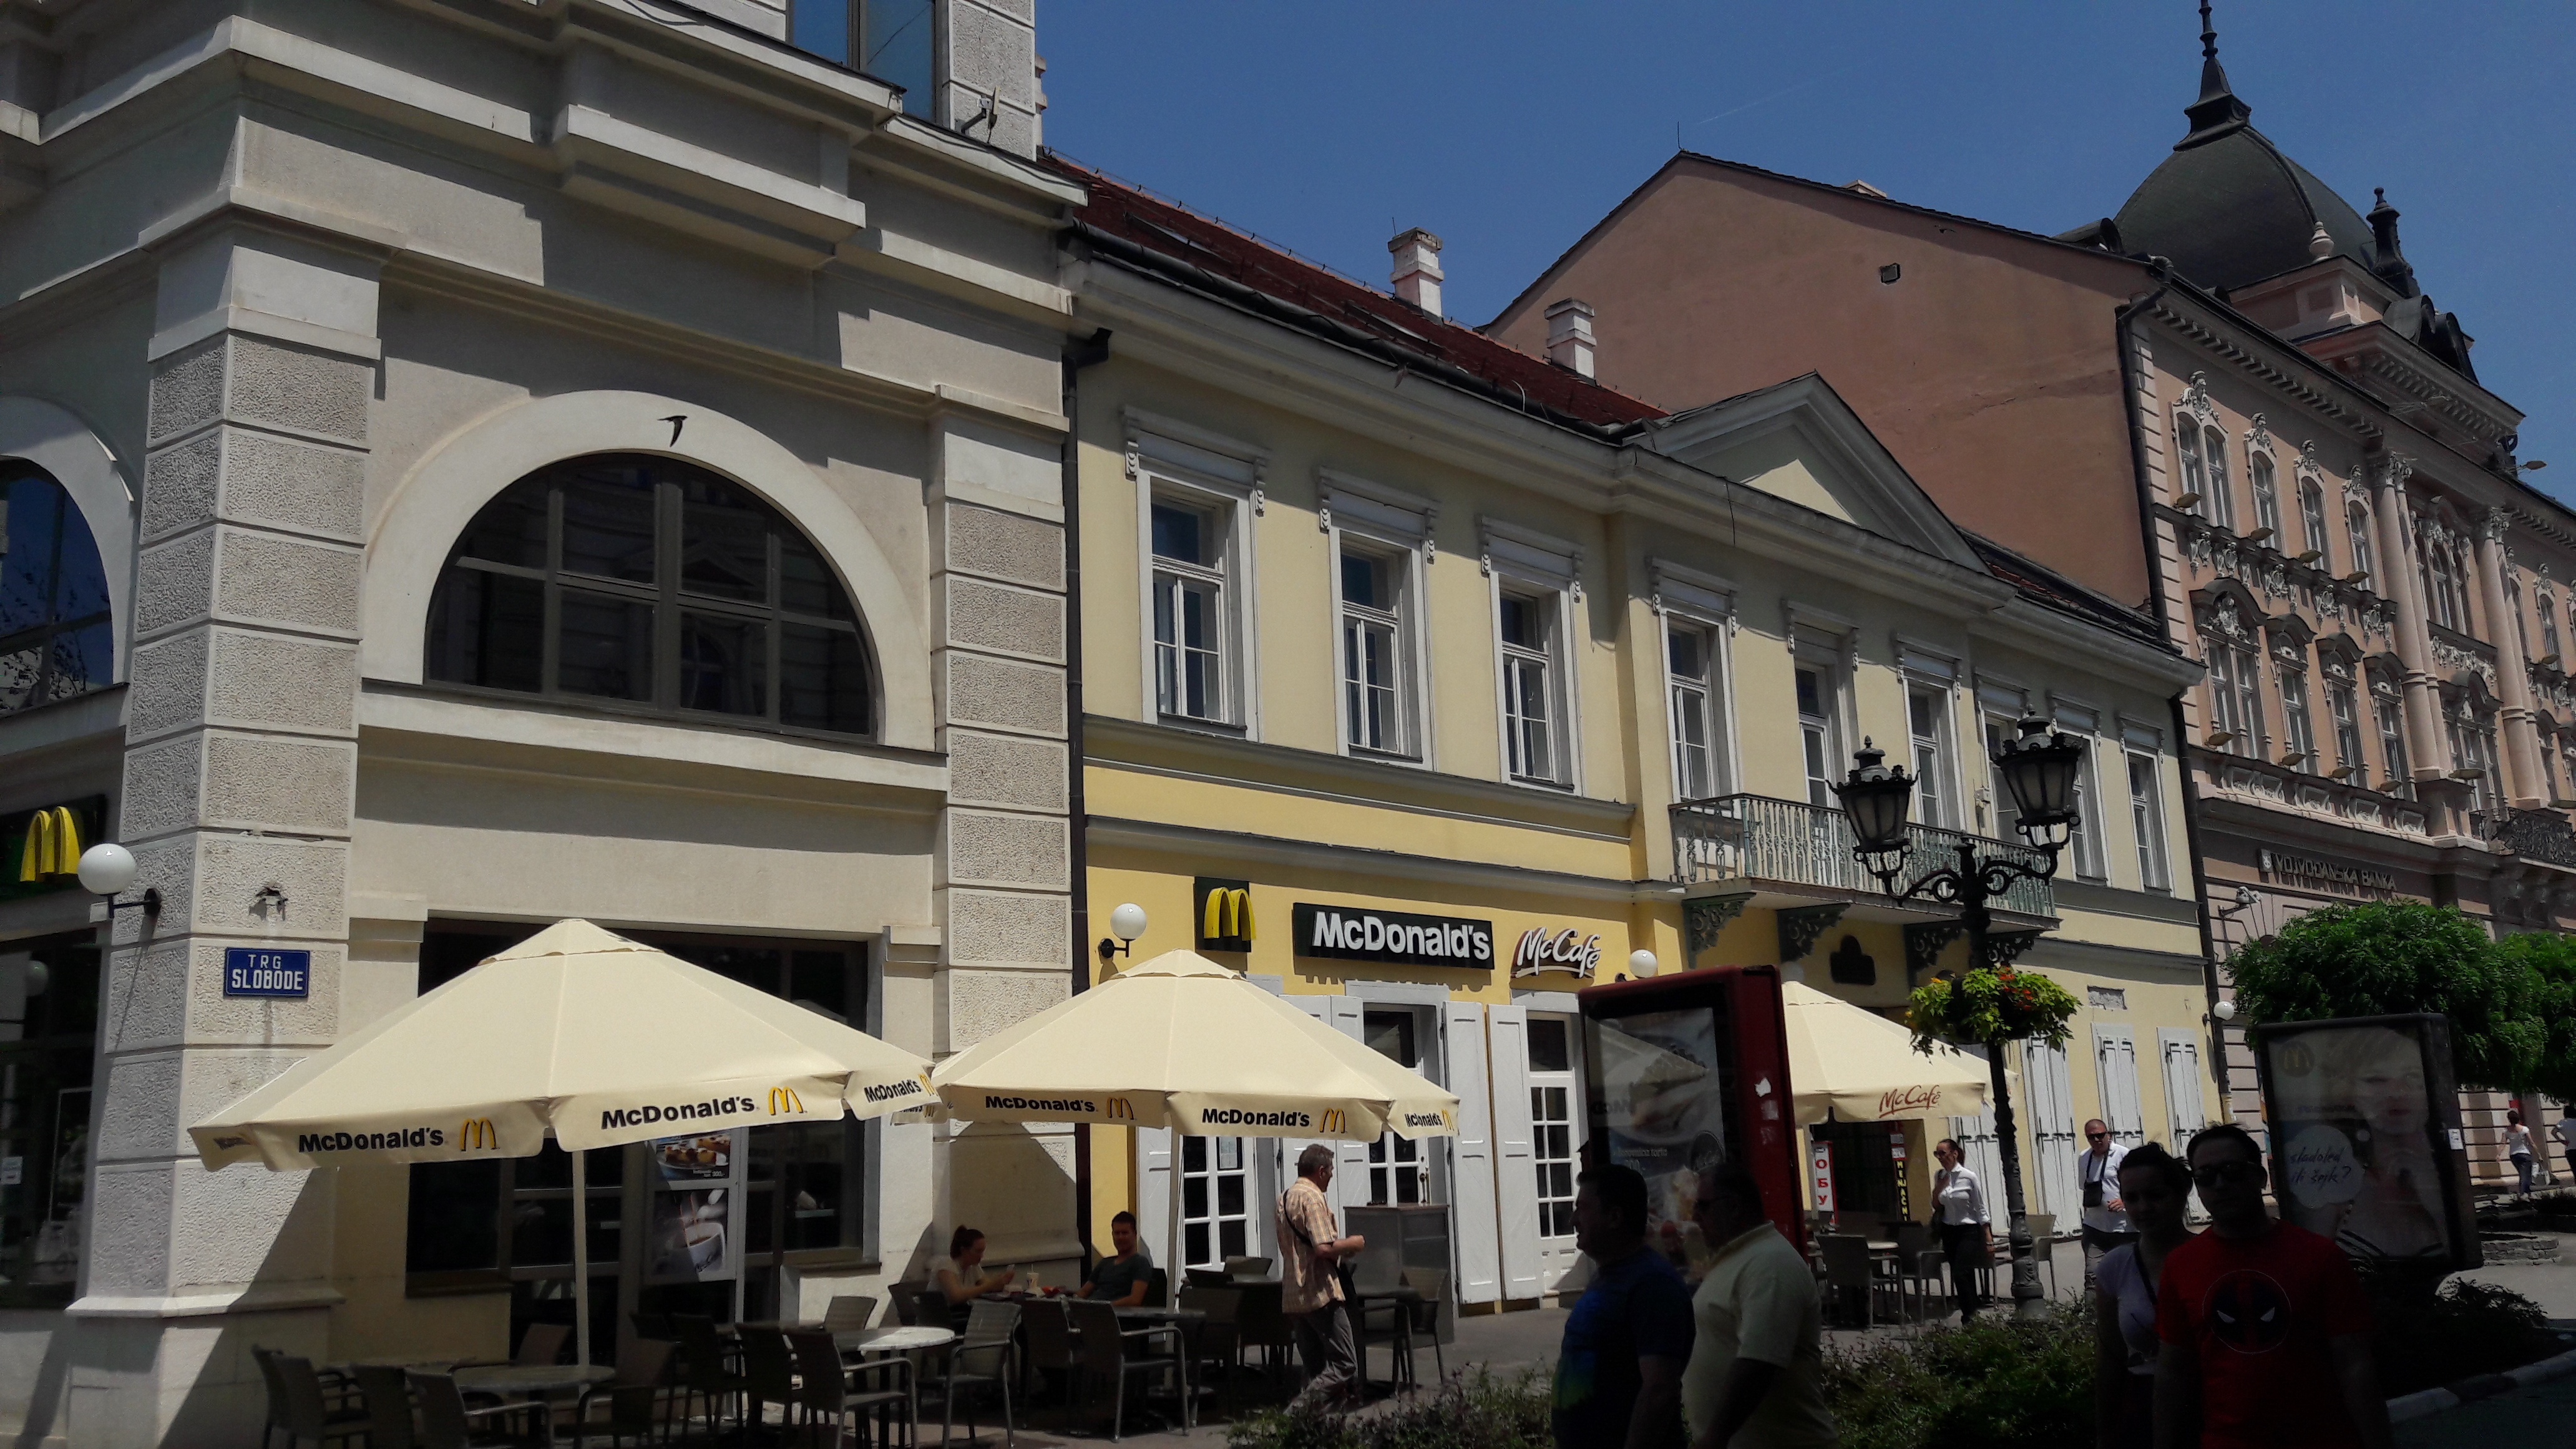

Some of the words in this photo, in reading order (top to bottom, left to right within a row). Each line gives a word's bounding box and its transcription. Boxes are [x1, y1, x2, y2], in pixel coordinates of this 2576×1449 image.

[1312, 911, 1490, 961] McDonald's
[248, 954, 281, 969] TRG
[1514, 927, 1601, 978] McCafé
[232, 968, 304, 990] SLOBODE
[864, 1079, 922, 1103] McDonald's
[601, 1096, 754, 1130] McDonald's
[985, 1096, 1096, 1113] McDonald's
[1202, 1108, 1310, 1127] McDonald's
[299, 1127, 444, 1153] McDonald's
